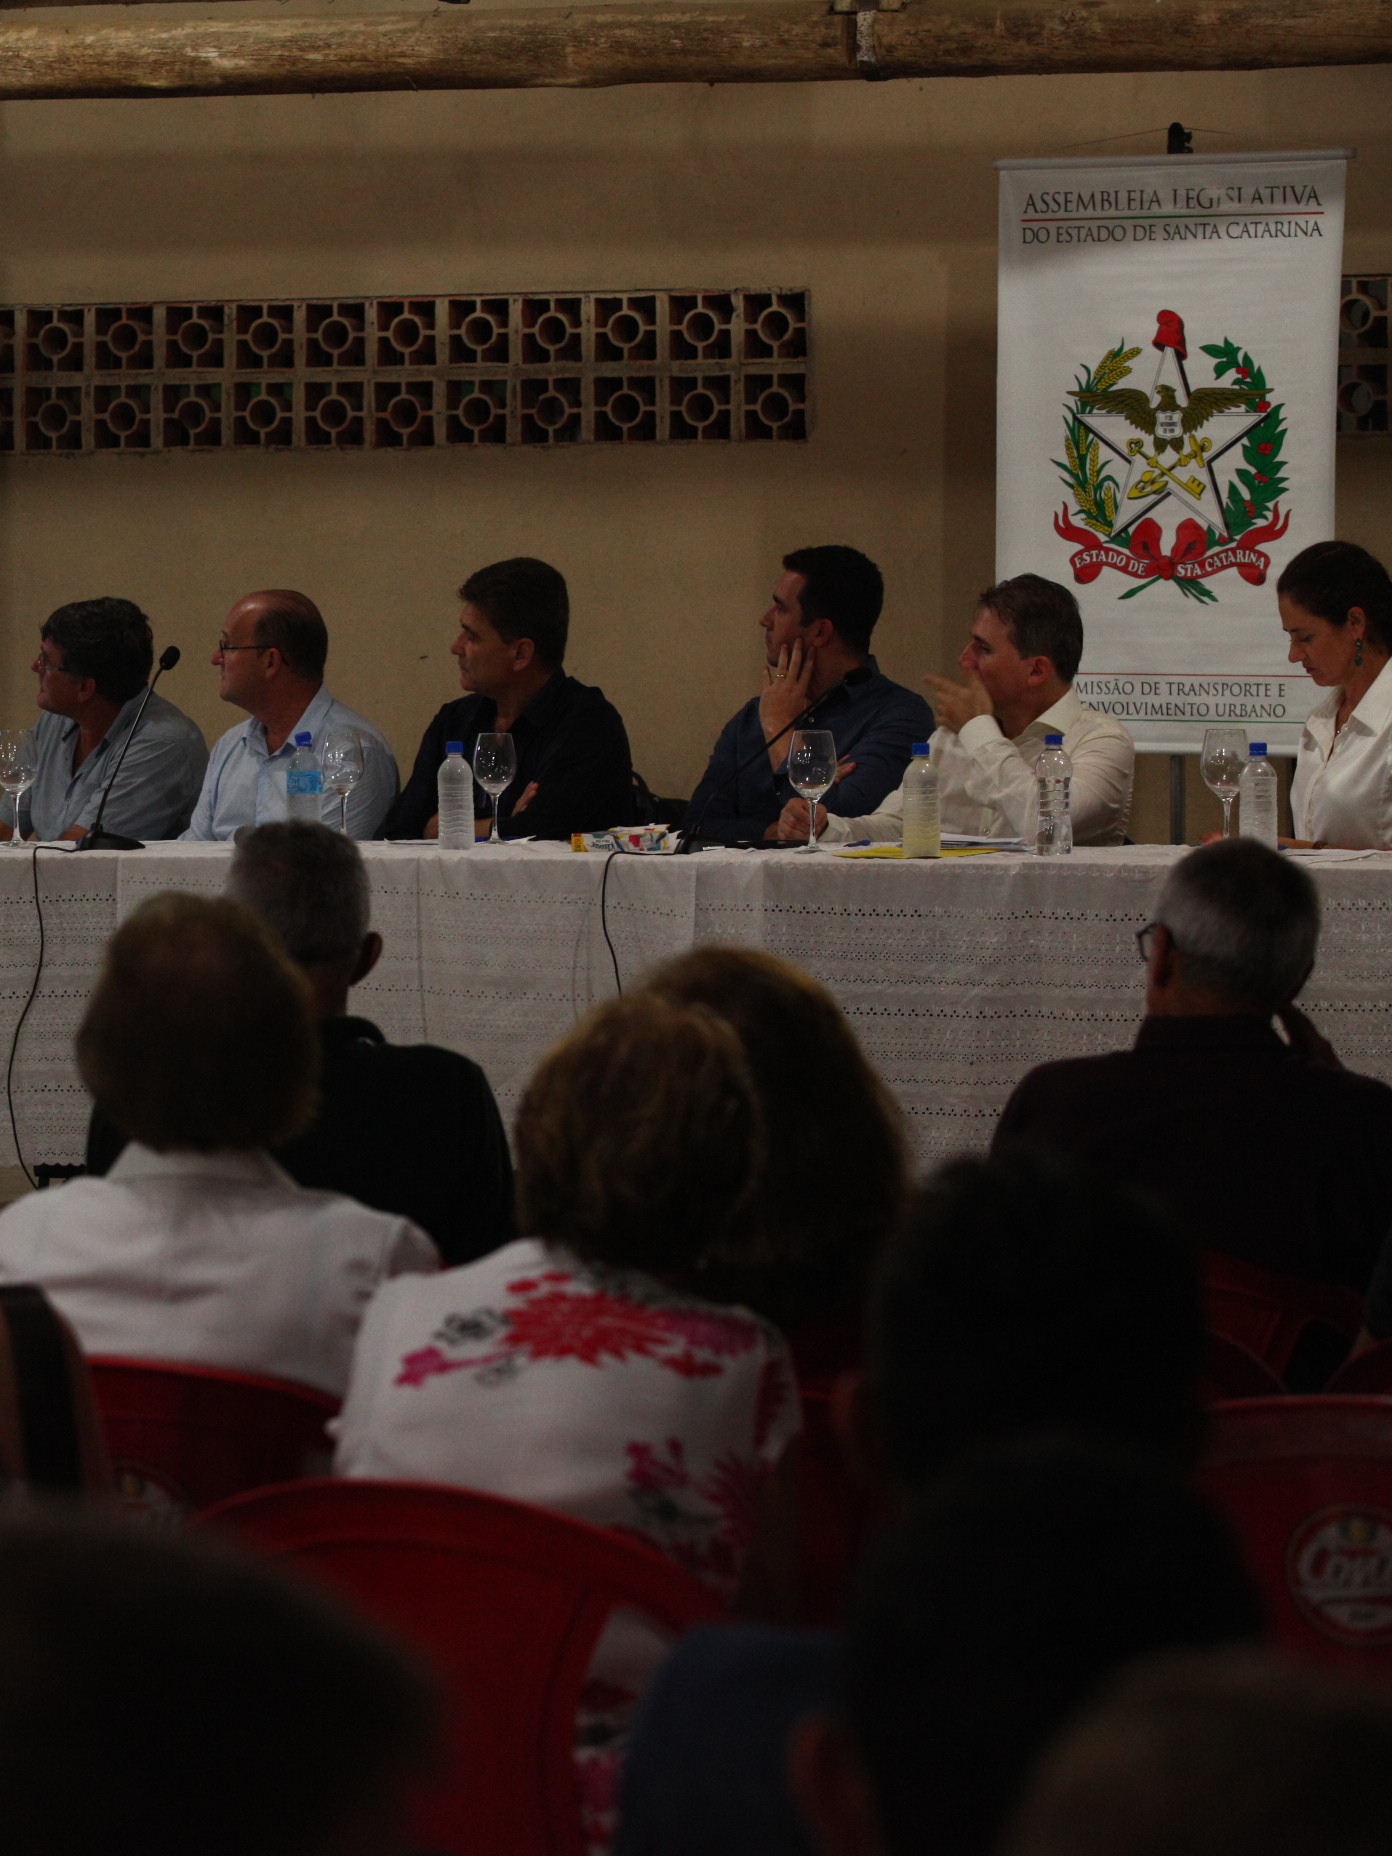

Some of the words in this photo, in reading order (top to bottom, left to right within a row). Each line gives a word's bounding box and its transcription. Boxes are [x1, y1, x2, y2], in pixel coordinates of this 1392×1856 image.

[1022, 188, 1162, 215] ASSEMBLEIA
[1021, 226, 1050, 245] DO
[1055, 223, 1127, 244] ESTADO
[1132, 224, 1157, 242] DE
[1162, 221, 1223, 241] SANTA
[1225, 220, 1324, 240] CATARINA
[1074, 549, 1126, 569] ESTADO
[1127, 558, 1147, 577] DE
[1206, 550, 1265, 570] CATARINA
[1075, 679, 1135, 695] MISSÃO
[1140, 681, 1160, 695] DE
[1165, 681, 1272, 697] TRANSPORTE
[1279, 683, 1287, 698] E
[1080, 700, 1210, 717] NVOLVIMENTO
[1215, 703, 1287, 718] URBANO
